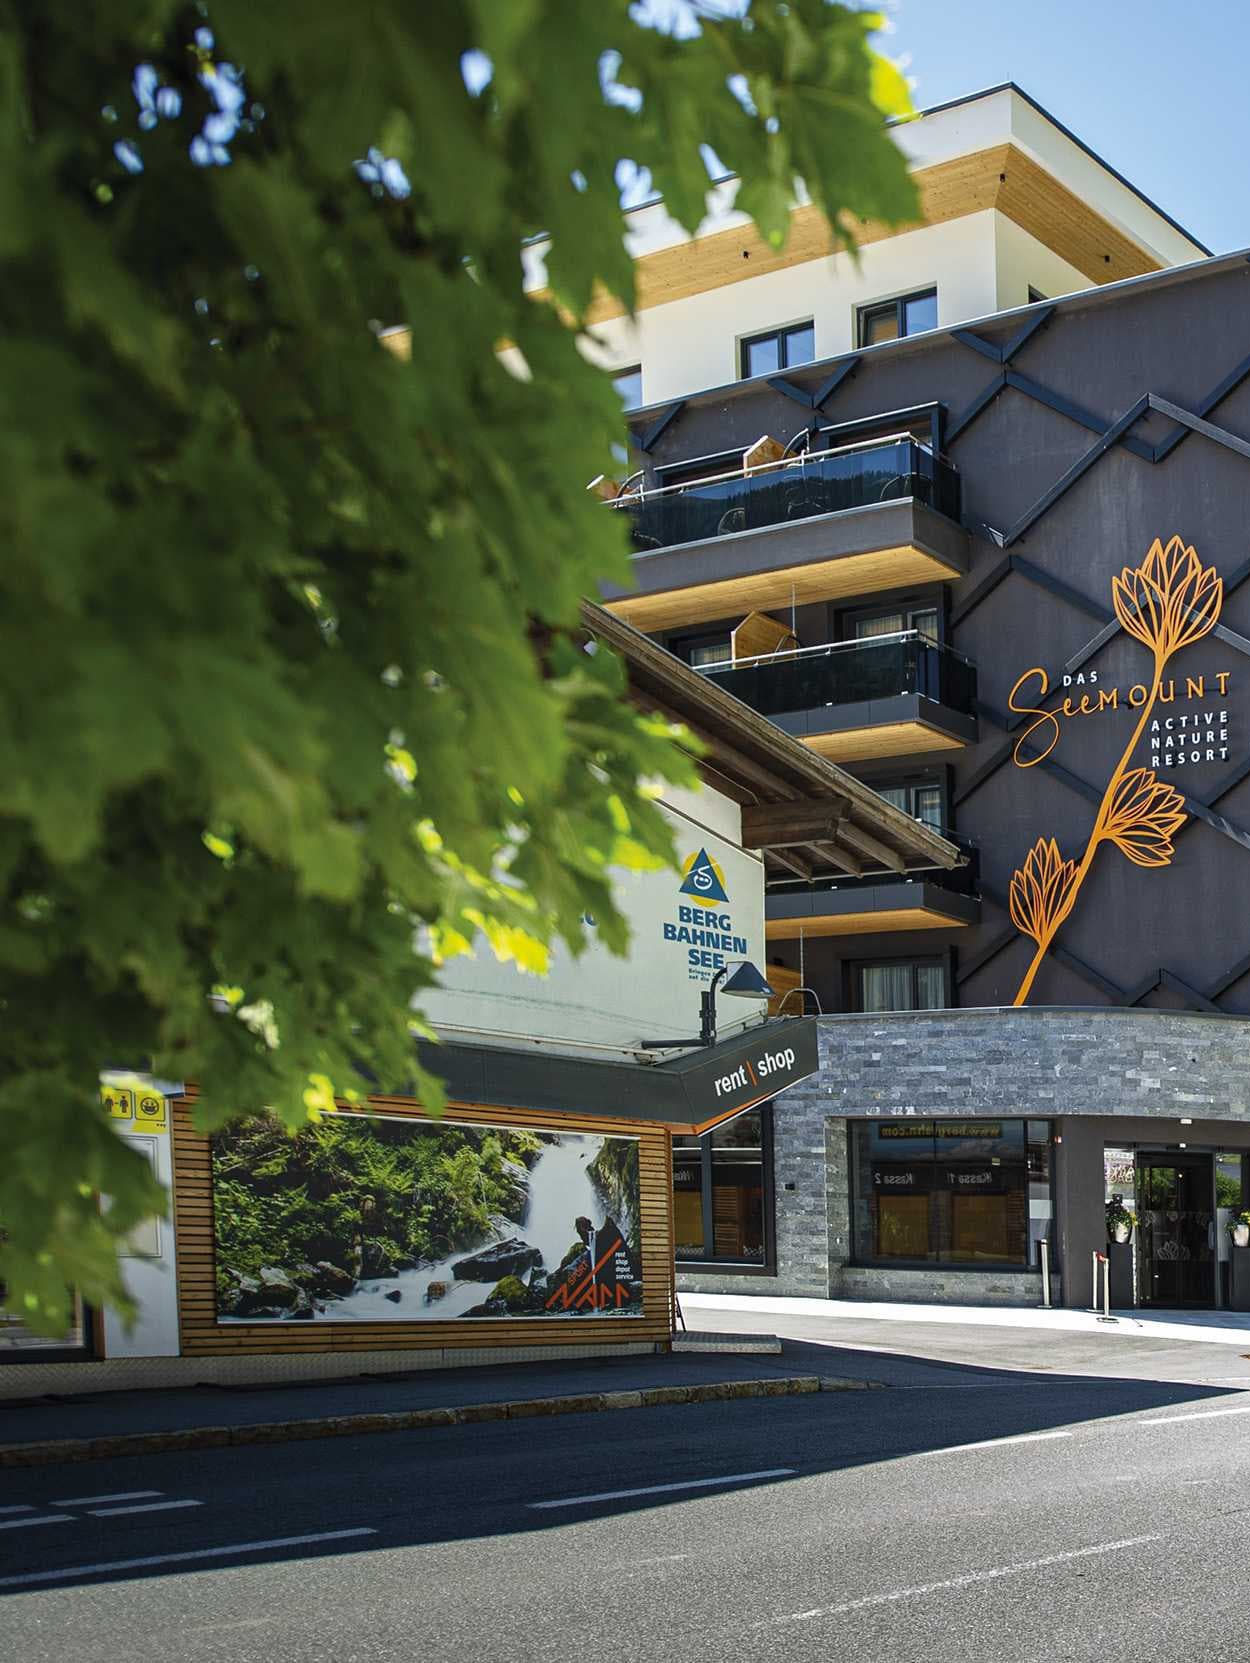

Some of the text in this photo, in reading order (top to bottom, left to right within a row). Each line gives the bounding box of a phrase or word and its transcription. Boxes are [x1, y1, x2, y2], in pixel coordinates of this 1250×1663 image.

[1062, 671, 1098, 687] DAS
[1151, 710, 1228, 732] ACTIVE
[1151, 729, 1228, 749] NATURE
[1152, 747, 1228, 767] RESORT
[678, 905, 731, 931] BERG
[663, 923, 747, 954] BAHNEN
[688, 950, 725, 970] SEE
[714, 1047, 796, 1097] rent shop
